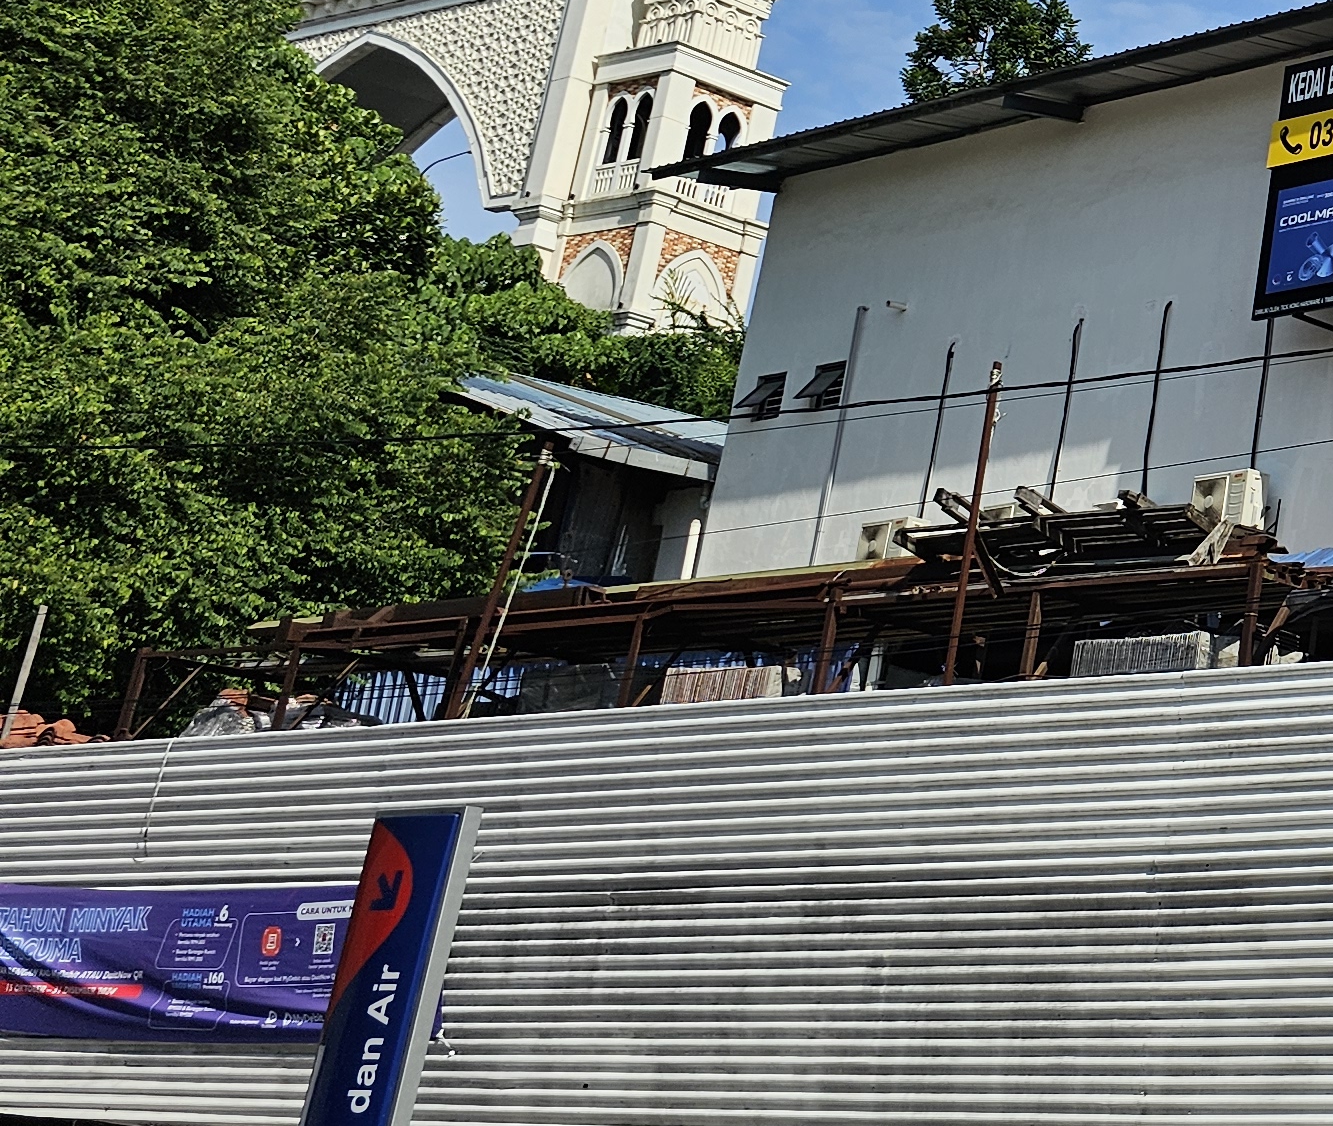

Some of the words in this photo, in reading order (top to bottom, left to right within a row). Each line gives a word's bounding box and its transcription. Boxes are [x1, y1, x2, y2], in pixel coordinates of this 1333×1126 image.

[1288, 67, 1326, 103] KEDAI
[69, 906, 153, 932] MINYAK
[182, 908, 215, 917] HADIAH
[300, 907, 320, 915] CARA
[321, 906, 347, 914] UNTUK
[181, 918, 212, 927] UTAMA
[347, 1037, 385, 1114] dan
[366, 964, 401, 1025] Air
